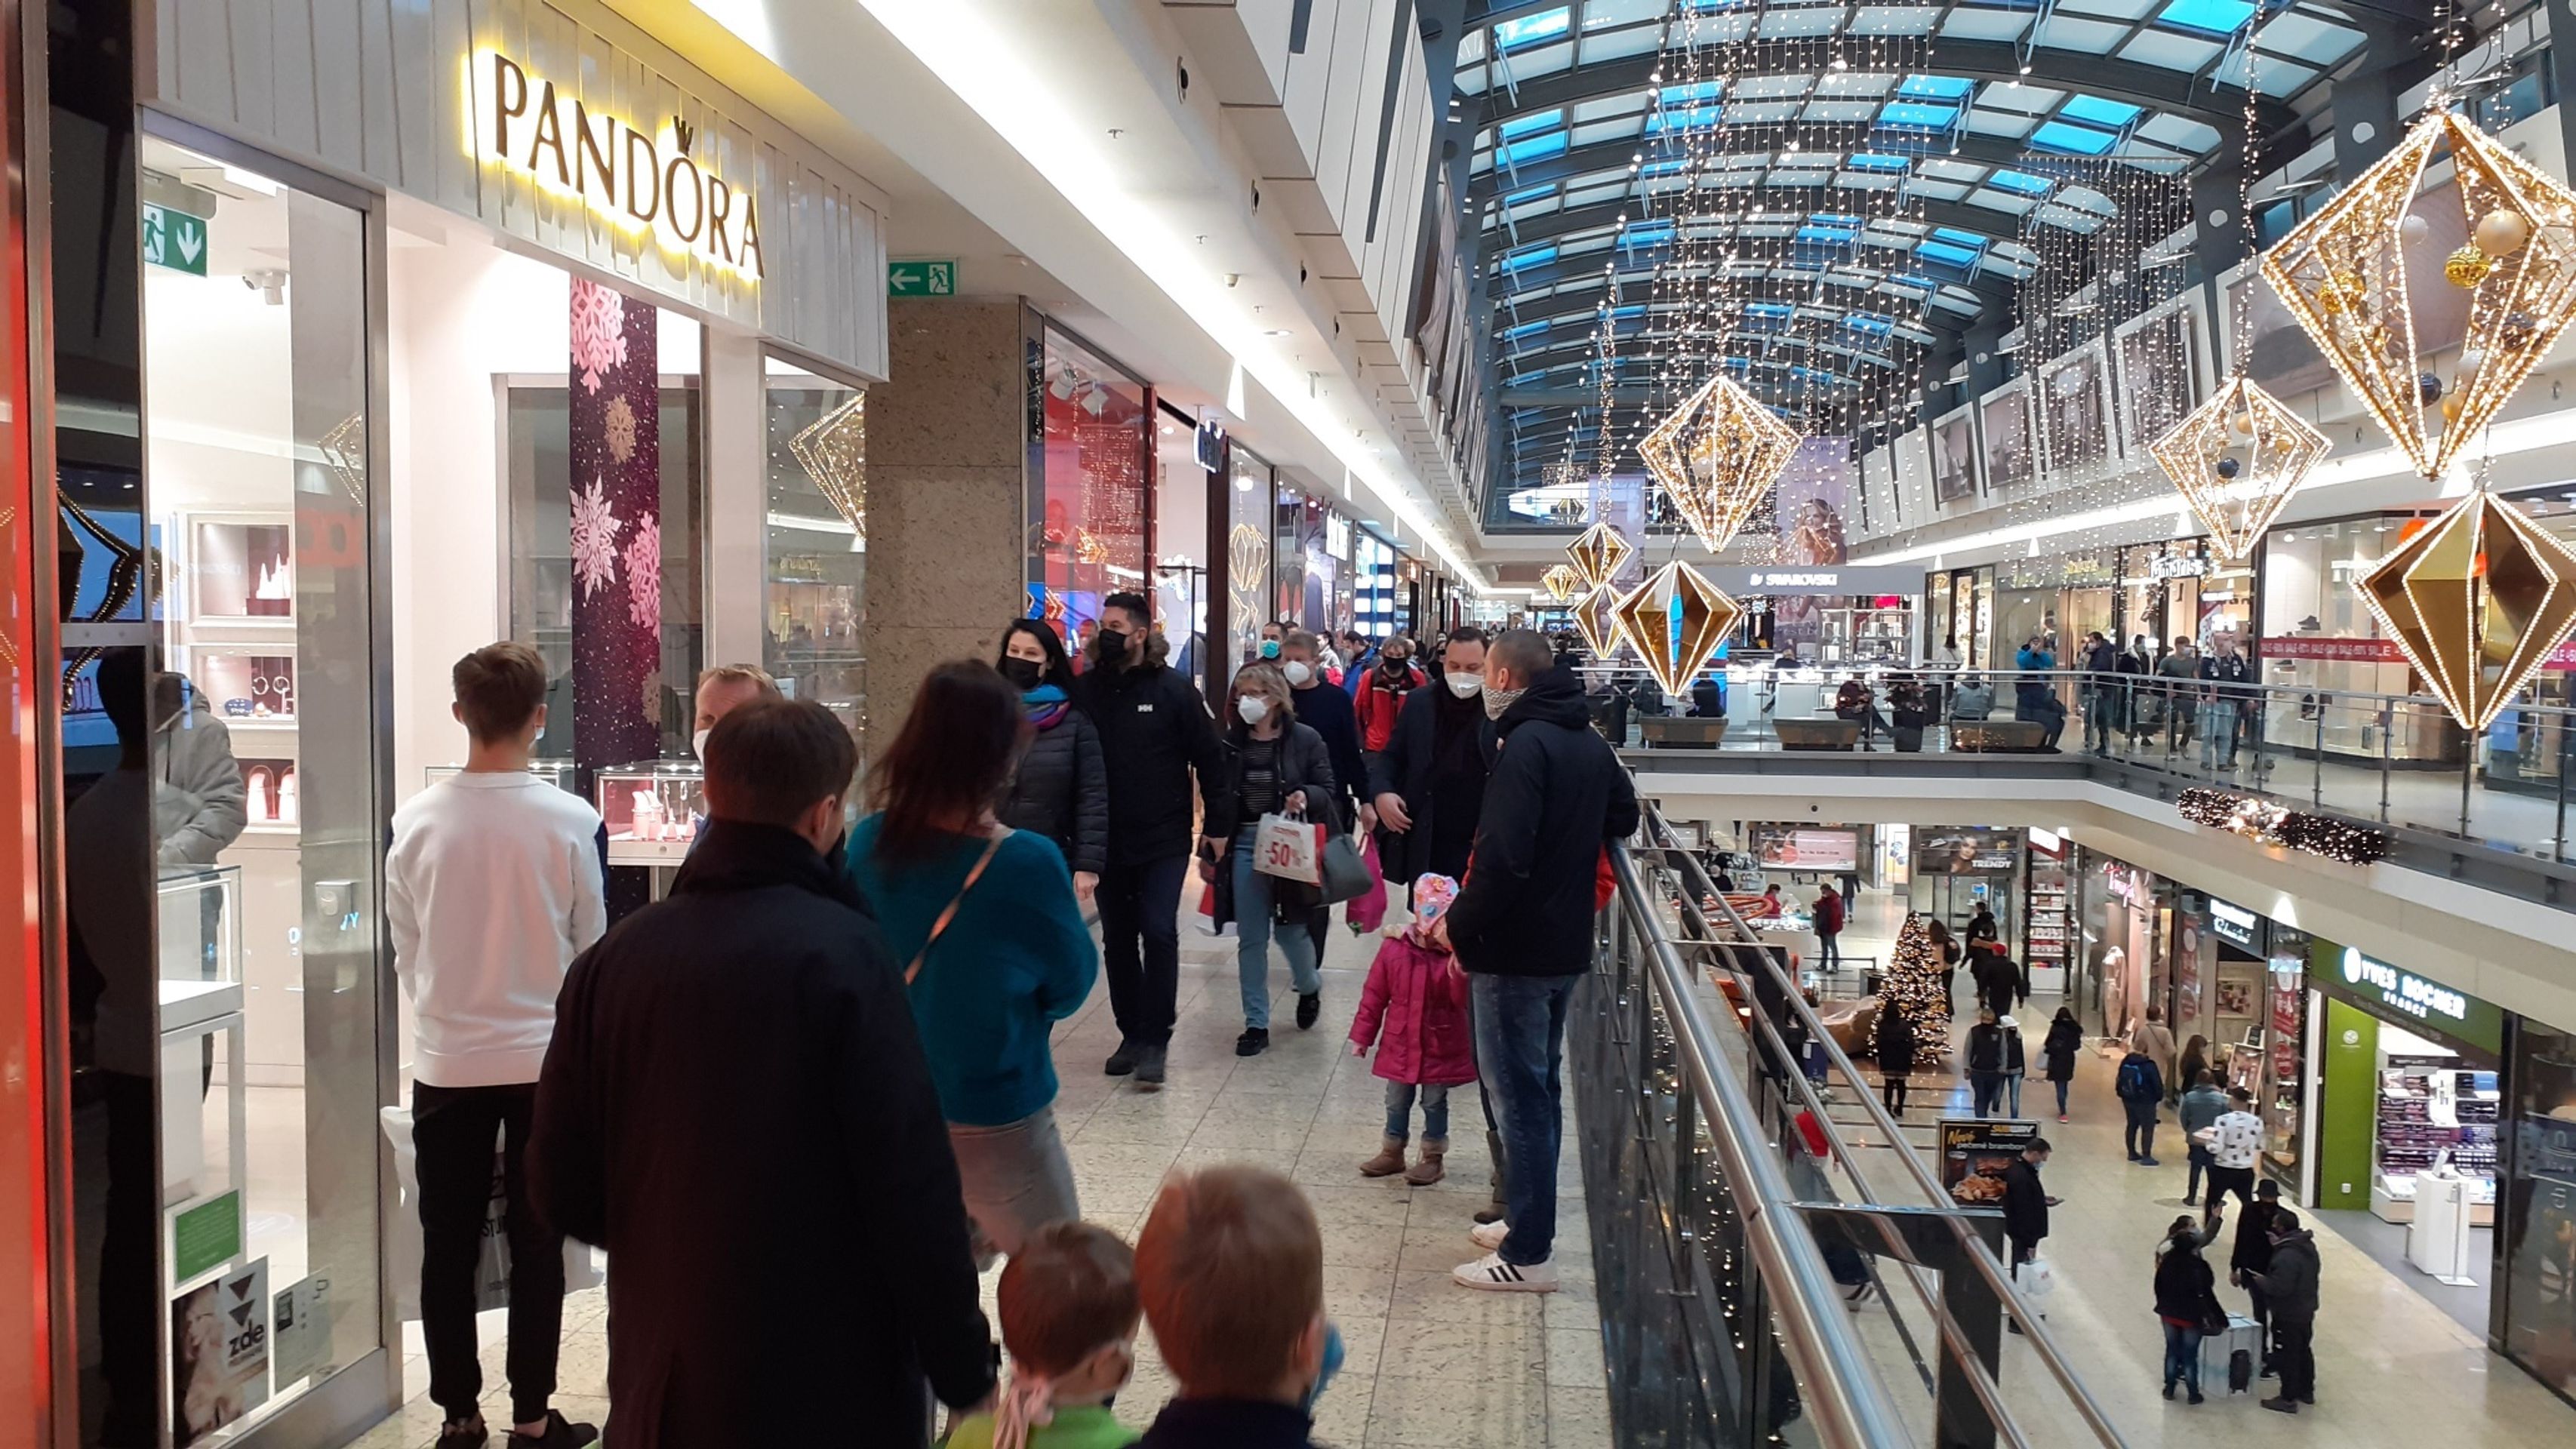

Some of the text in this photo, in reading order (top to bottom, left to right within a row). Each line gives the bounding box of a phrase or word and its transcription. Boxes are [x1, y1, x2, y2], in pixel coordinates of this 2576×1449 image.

[494, 54, 765, 278] PANDORA
[1766, 574, 1837, 586] SWAROVSKI
[1971, 860, 2012, 869] TRENDY
[2362, 959, 2397, 990] YVES
[2402, 974, 2466, 1020] ROCHER
[2383, 991, 2427, 1018] FRANCE
[229, 1319, 264, 1357] zde
